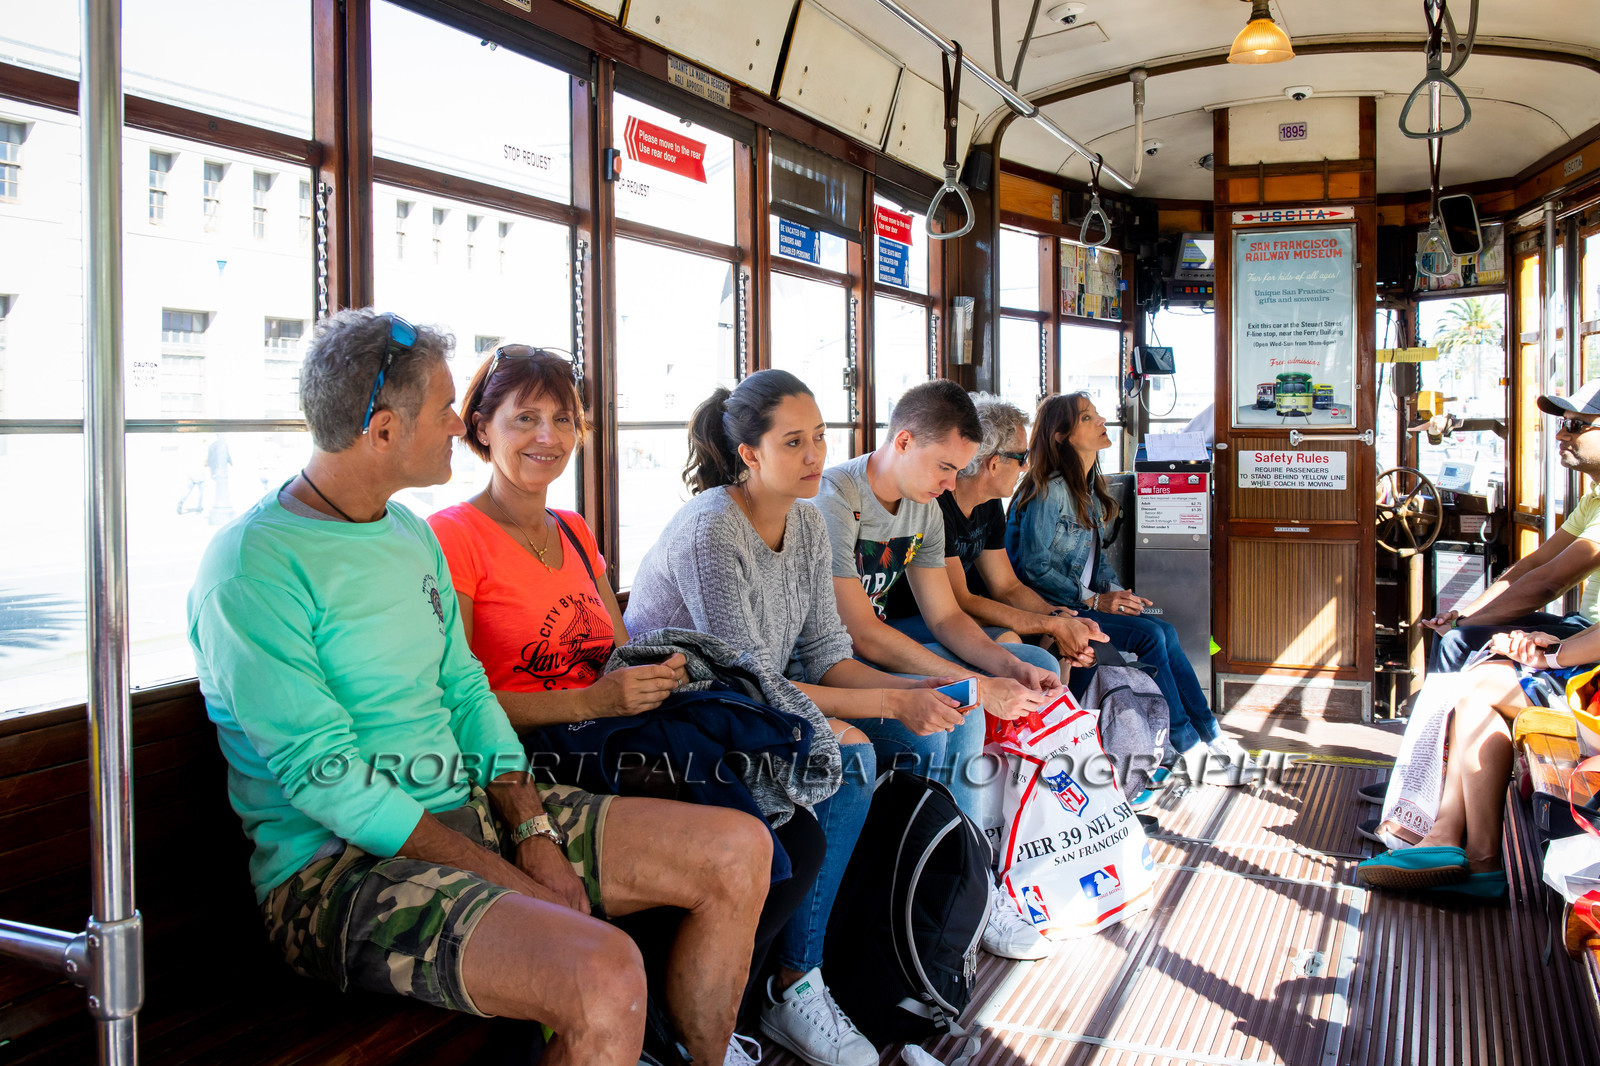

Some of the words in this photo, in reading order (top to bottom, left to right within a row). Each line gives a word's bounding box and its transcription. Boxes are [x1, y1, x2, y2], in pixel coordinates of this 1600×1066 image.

[1281, 125, 1305, 139] 1895
[639, 129, 658, 145] Please
[659, 138, 674, 150] move
[675, 142, 681, 153] to
[681, 145, 690, 156] the
[691, 150, 701, 160] rear
[504, 144, 520, 161] STOP
[523, 150, 551, 170] REQUEST
[639, 142, 650, 154] Use
[651, 148, 662, 159] rear
[664, 151, 677, 163] door
[627, 179, 650, 197] REQUEST
[1260, 210, 1325, 222] USCITA
[785, 226, 799, 237] VACATED
[780, 234, 794, 245] SENIORS
[1250, 241, 1270, 252] SAN
[1274, 239, 1337, 250] FRANCISCO
[780, 244, 795, 256] DISABLED
[796, 250, 810, 260] PERSONS
[1245, 250, 1290, 262] RAILWAY
[1293, 248, 1342, 259] MUSEUM
[1247, 273, 1261, 282] Fun
[1262, 273, 1275, 283] for
[1278, 271, 1294, 281] kids
[1295, 271, 1305, 281] of
[1306, 270, 1318, 279] all
[1255, 290, 1280, 299] Unique
[1259, 296, 1277, 305] gifts
[1263, 330, 1277, 338] stop,
[1303, 329, 1318, 337] Ferry
[1270, 358, 1284, 367] Free
[1255, 452, 1293, 465] Safety
[1296, 453, 1329, 463] Rules
[540, 606, 560, 638] CITY
[559, 594, 575, 608] BY
[579, 593, 601, 607] THE
[1058, 827, 1082, 849] 39
[1085, 813, 1115, 839] NFL
[1054, 852, 1075, 866] SAN
[1079, 826, 1129, 858] FRANCISCO
